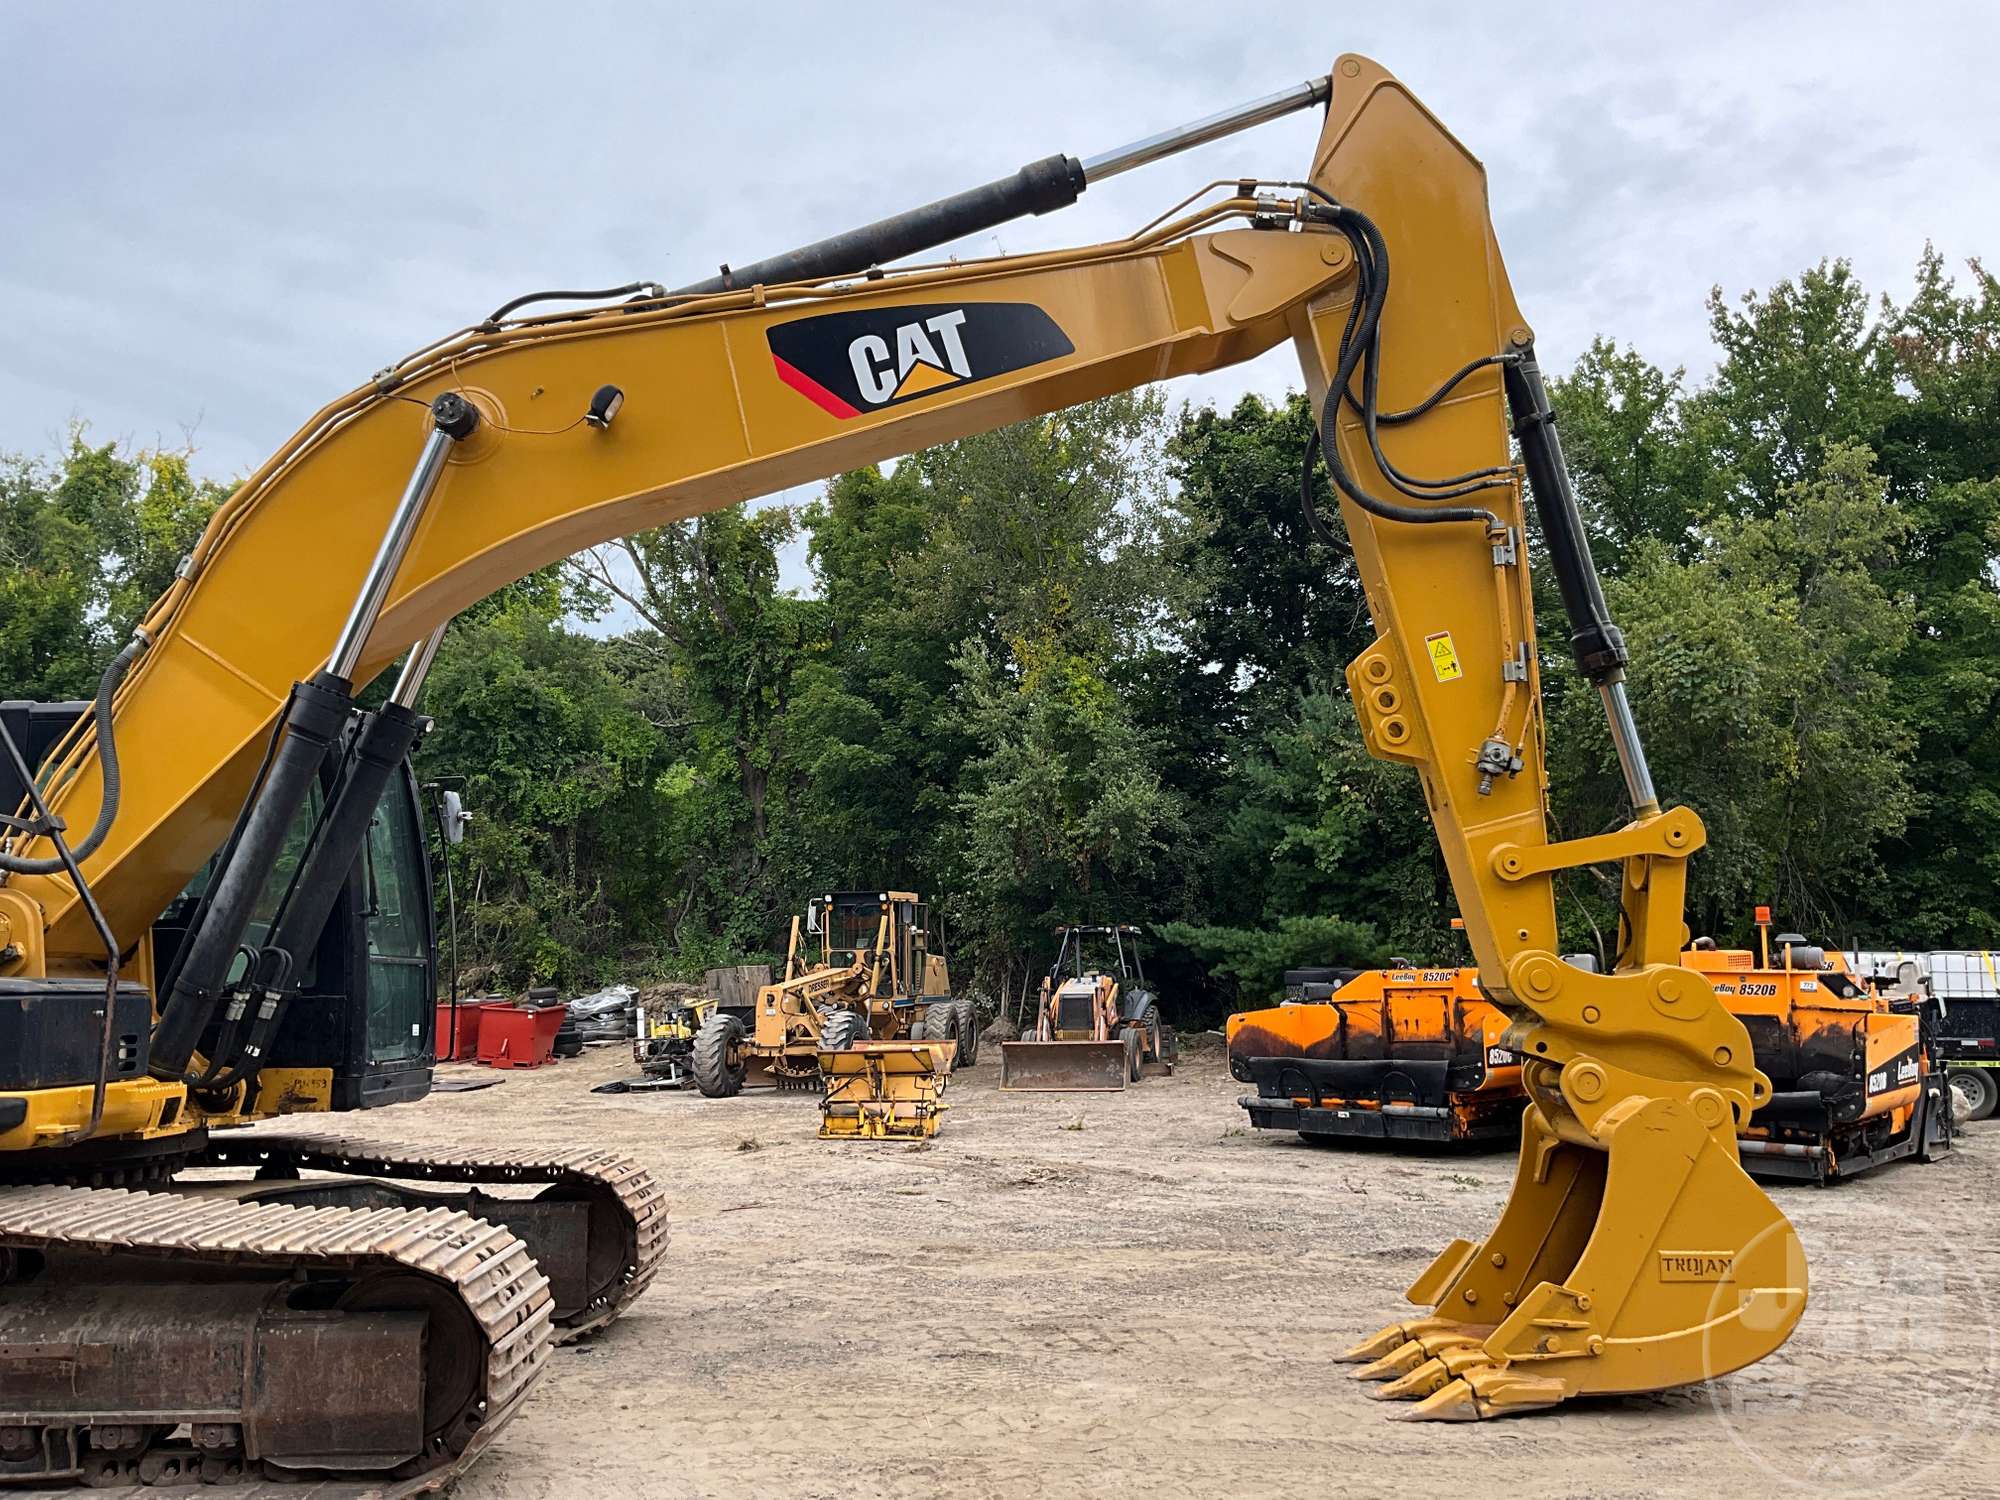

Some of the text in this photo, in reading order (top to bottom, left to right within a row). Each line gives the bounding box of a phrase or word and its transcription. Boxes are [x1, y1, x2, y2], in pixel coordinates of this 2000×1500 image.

[848, 309, 972, 404] CAT
[1423, 972, 1451, 982] 8520C
[808, 979, 830, 994] DRESSER
[1739, 984, 1777, 996] 8520B
[1661, 1257, 1733, 1277] TROJAN
